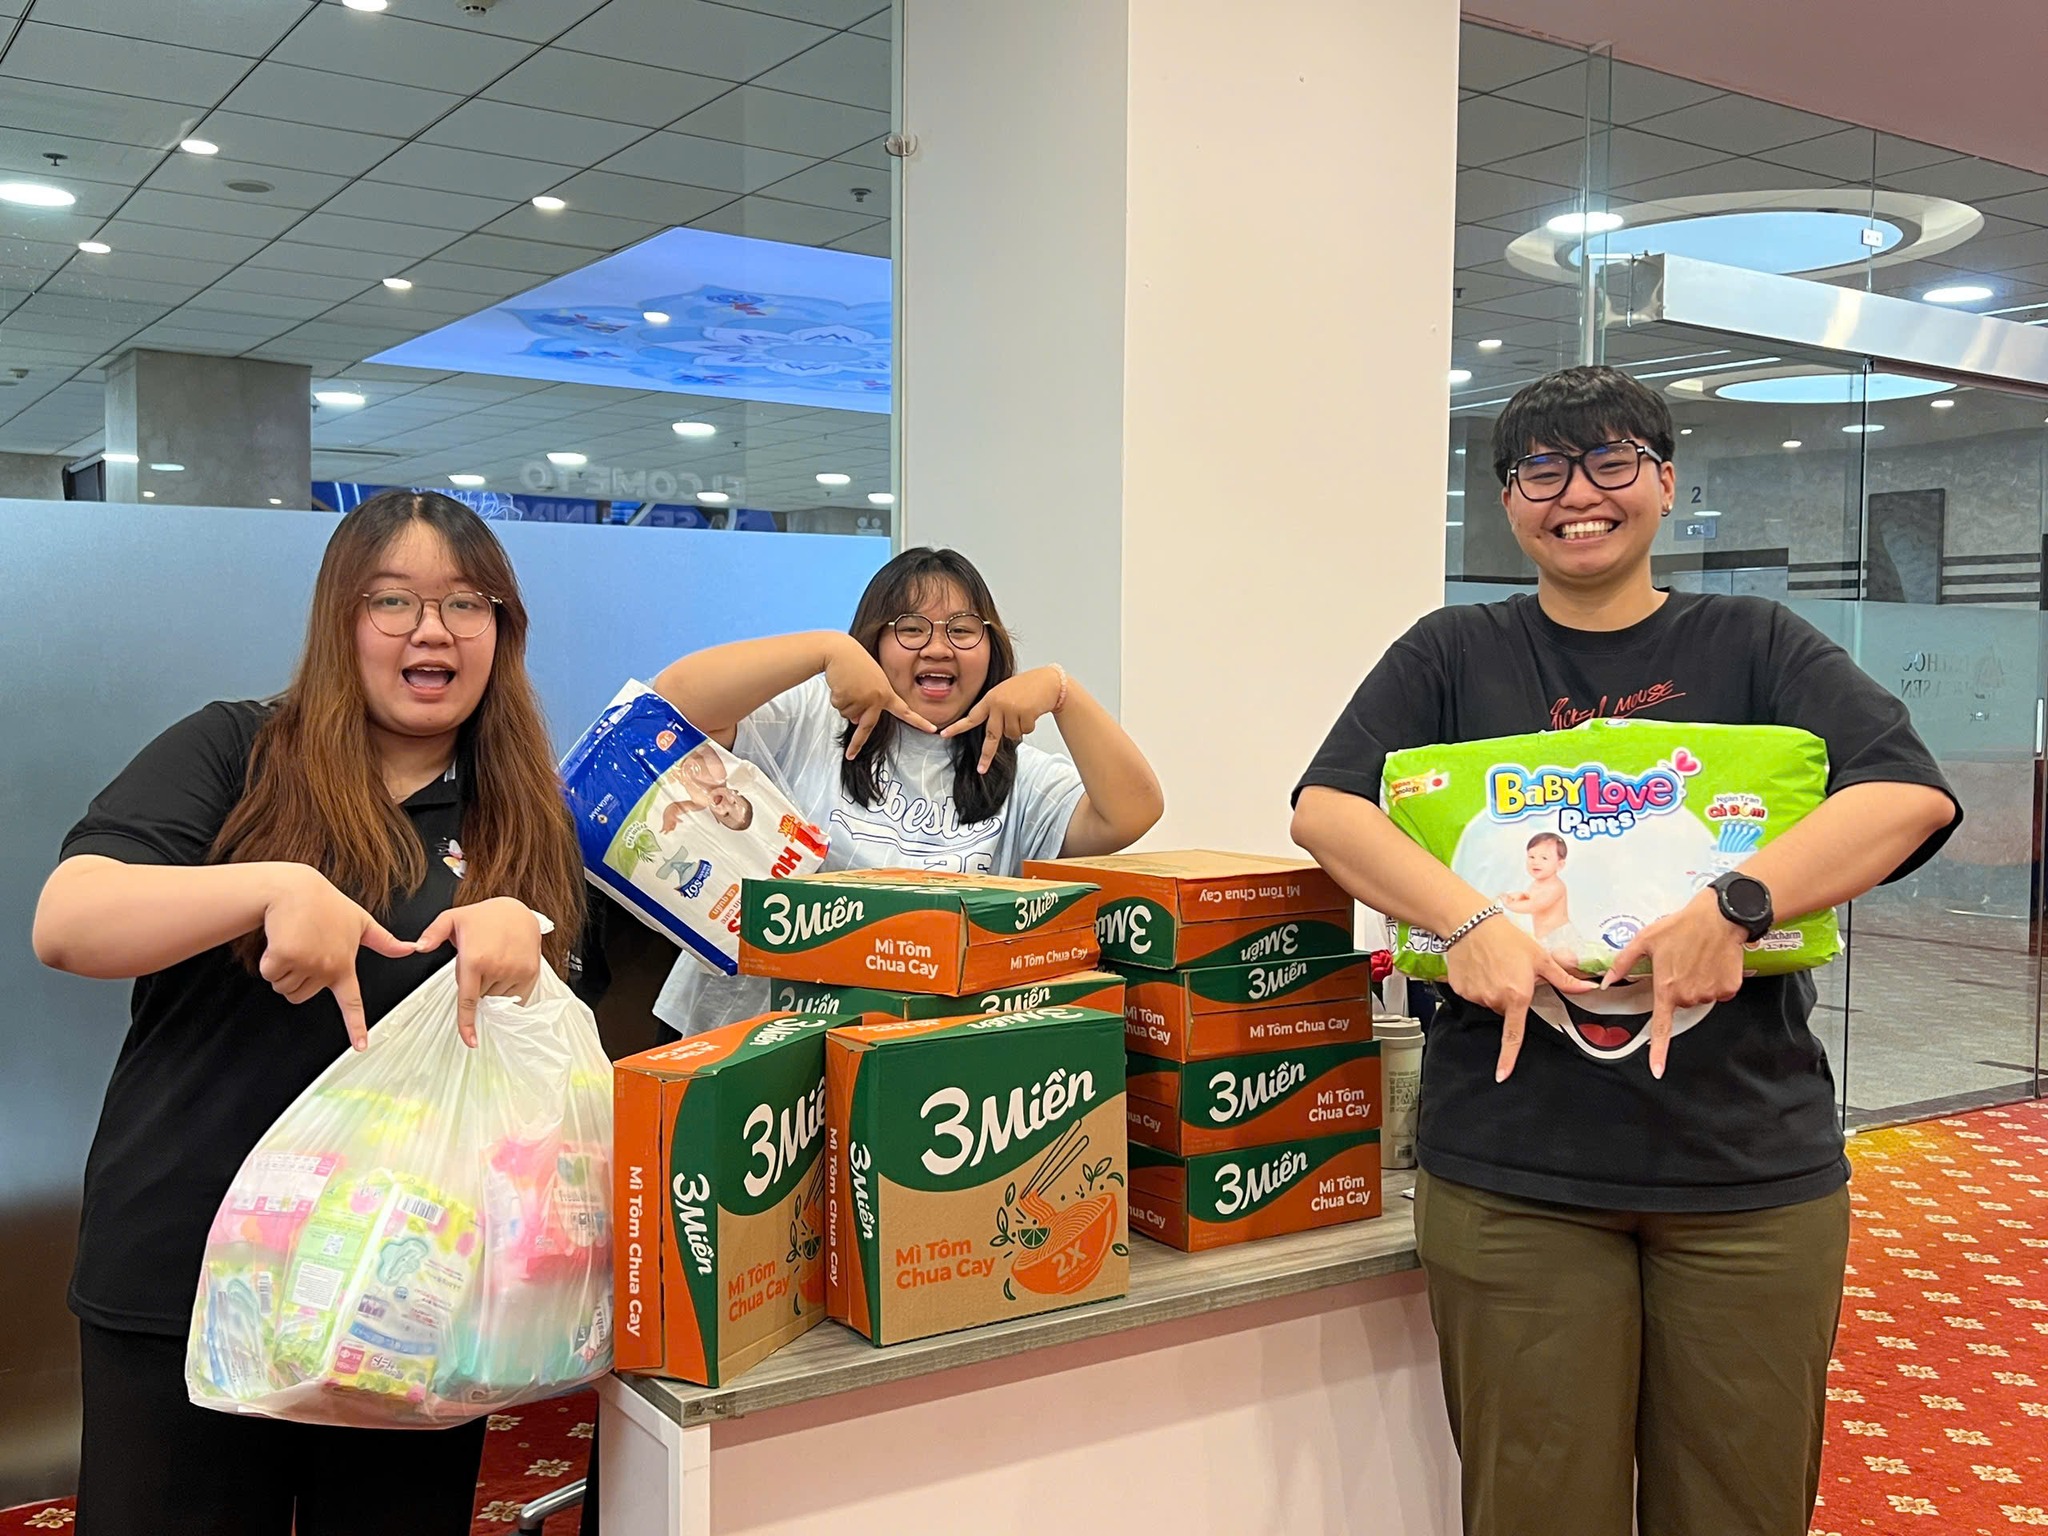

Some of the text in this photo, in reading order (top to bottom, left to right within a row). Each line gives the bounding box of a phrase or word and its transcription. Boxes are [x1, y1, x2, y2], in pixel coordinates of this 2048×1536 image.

[1691, 486, 1702, 504] 2
[1613, 679, 1675, 716] MOUSE
[1559, 807, 1636, 839] Pants
[875, 938, 931, 958] Mì Tôm
[1010, 946, 1088, 971] Mì Tôm Chua Cay
[866, 953, 939, 980] Chua Cay
[1139, 1007, 1165, 1026] Tôm
[1250, 1017, 1350, 1039] Mì Tôm Chua Cay
[1125, 1022, 1171, 1046] hua Cay
[1317, 1087, 1365, 1107] Mì Tôm
[1143, 1115, 1161, 1133] Cay
[1308, 1101, 1371, 1123] Chua Cay
[1319, 1176, 1365, 1195] Mì Tôm
[1311, 1188, 1371, 1212] Chua Cay
[1147, 1209, 1166, 1229] Cay
[626, 1165, 644, 1338] Mì Tôm Chua Cay
[895, 1237, 972, 1268] Mì Tôm
[728, 1258, 776, 1300] Mì Tôm
[895, 1256, 996, 1290] Chua Cay
[728, 1274, 790, 1323] Chua Cay
